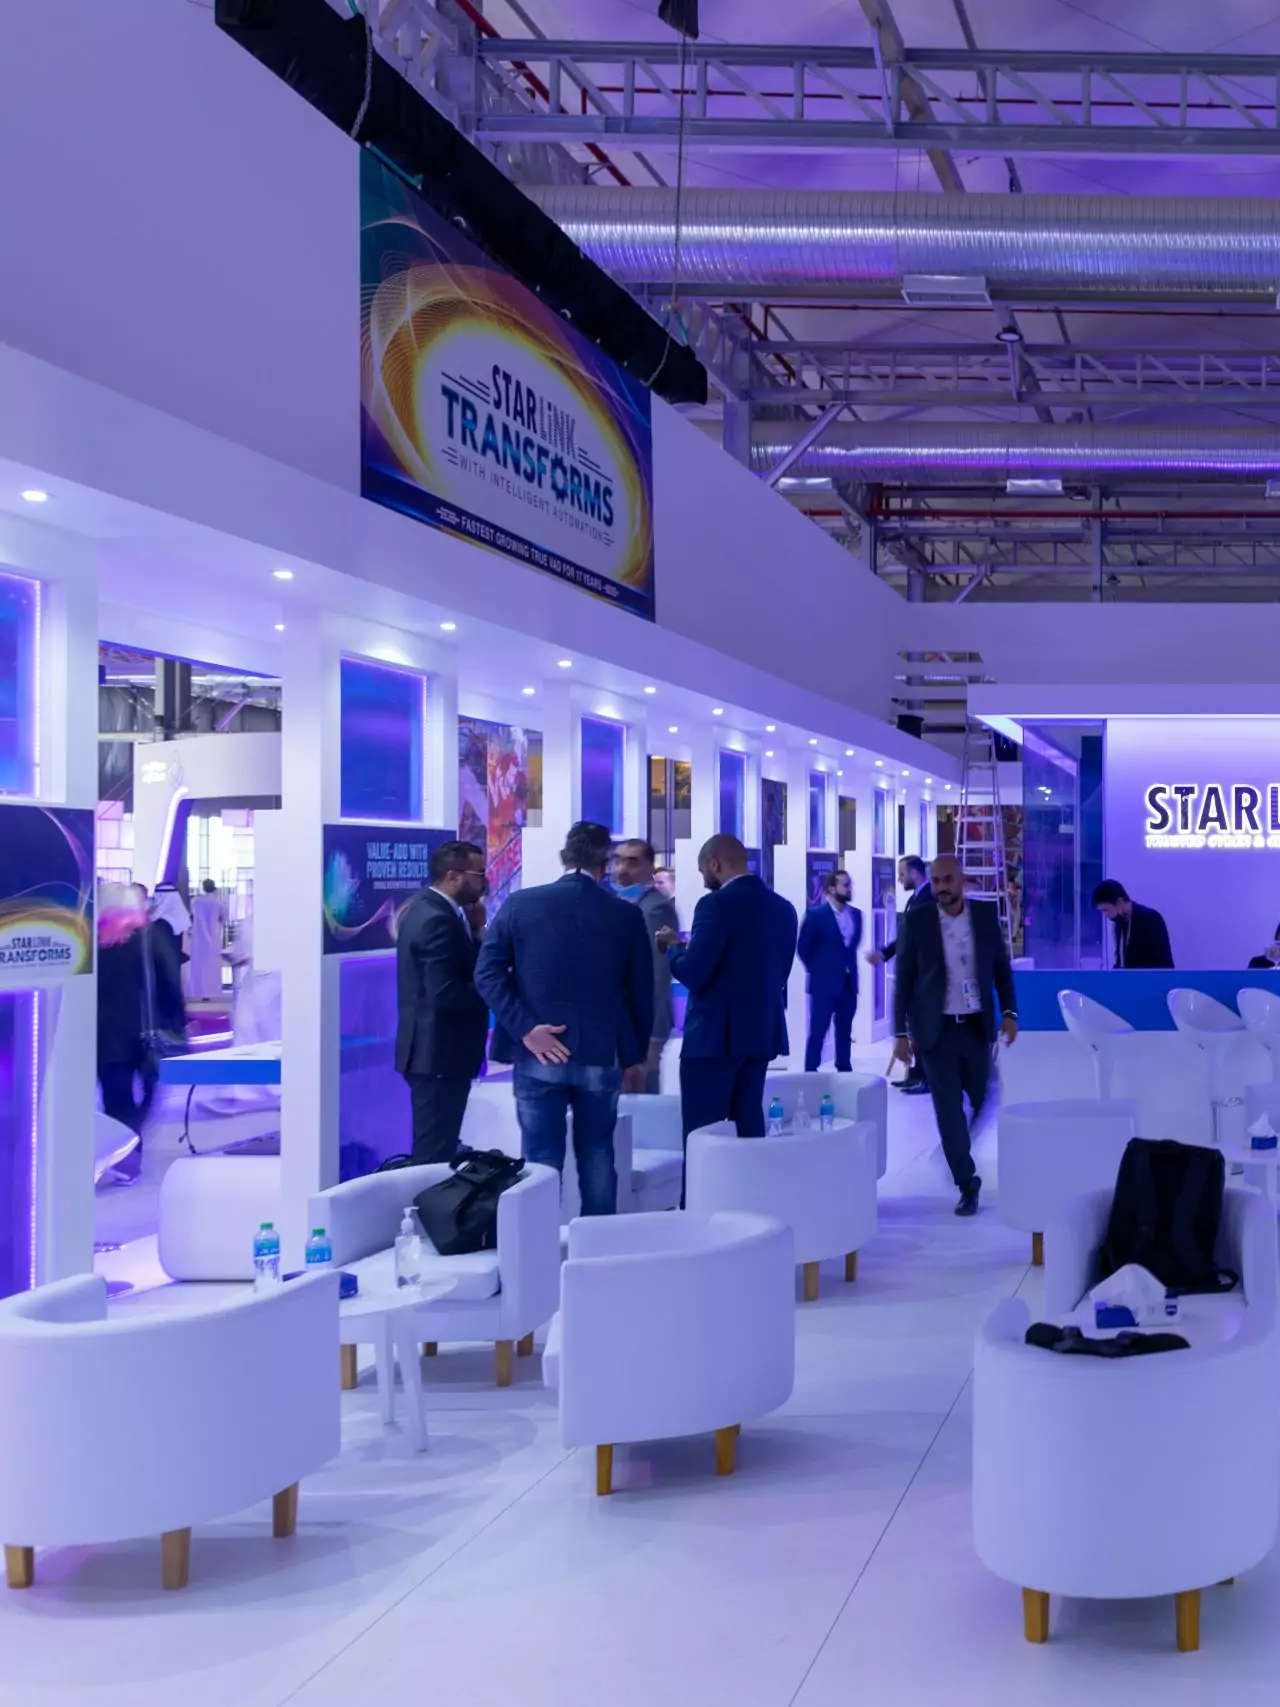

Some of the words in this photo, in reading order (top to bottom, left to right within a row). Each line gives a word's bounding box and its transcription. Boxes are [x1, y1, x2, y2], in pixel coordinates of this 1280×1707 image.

[441, 384, 614, 528] TRANSFORMS
[459, 453, 486, 481] WITH
[490, 470, 550, 514] INTELLIGENT
[553, 506, 604, 544] AUTOMATION
[461, 515, 494, 542] FASTEST
[495, 532, 530, 559] GROWING
[530, 547, 549, 568] TRUE
[549, 555, 562, 575] VAD
[562, 562, 576, 579] FOR
[583, 572, 602, 591] YEARS
[366, 842, 408, 860] VALUE-ADD
[409, 844, 428, 860] WITH
[366, 861, 397, 878] PROVEN
[398, 861, 428, 878] RESULTS
